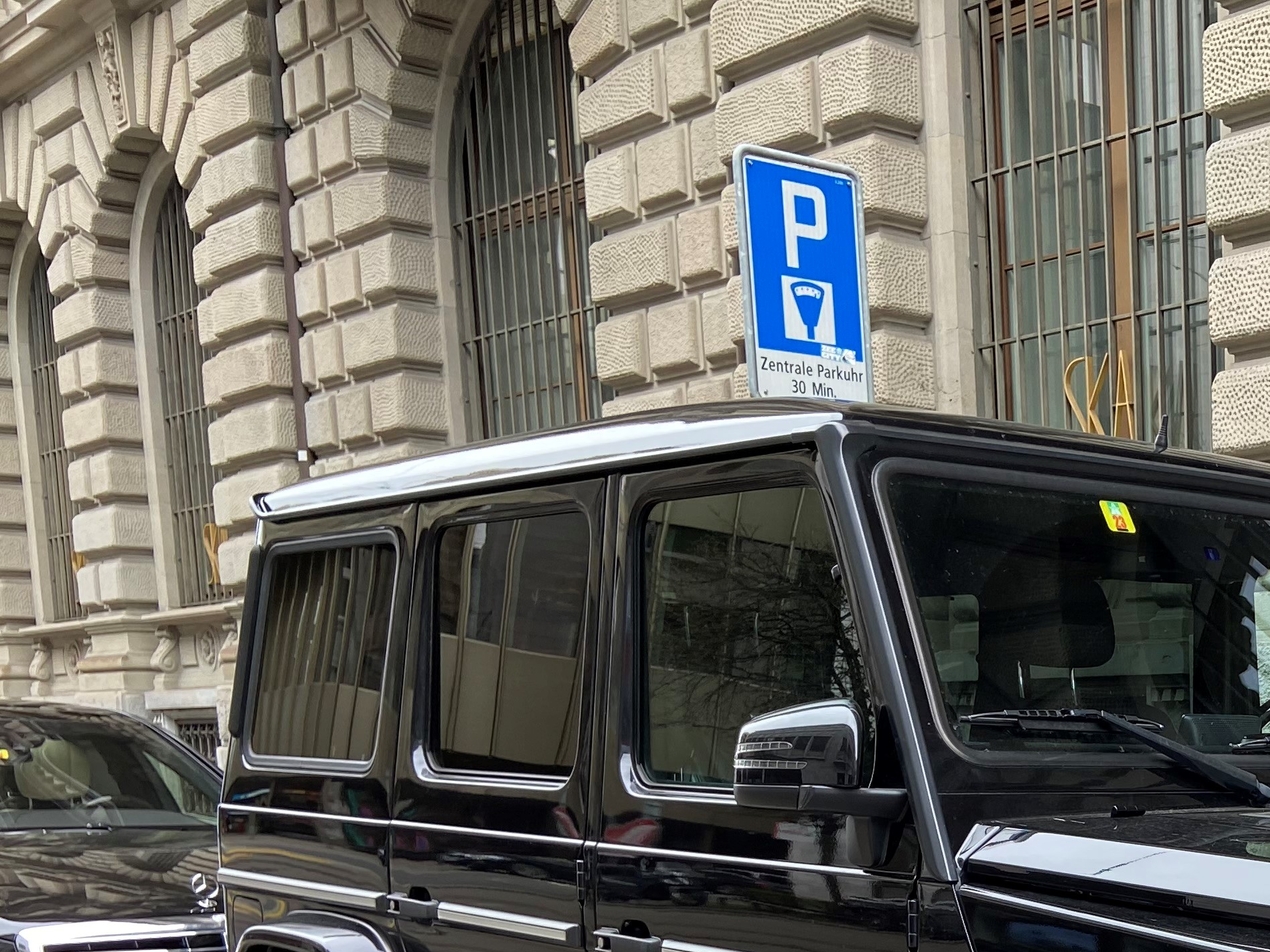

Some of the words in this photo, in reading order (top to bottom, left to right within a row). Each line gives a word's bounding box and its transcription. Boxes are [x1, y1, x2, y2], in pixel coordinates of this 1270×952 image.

[781, 179, 828, 268] P
[760, 356, 813, 376] Zentrale
[817, 364, 863, 382] Parkuhr
[791, 379, 806, 395] 30
[812, 382, 836, 398] Min.
[1063, 350, 1135, 440] SKA
